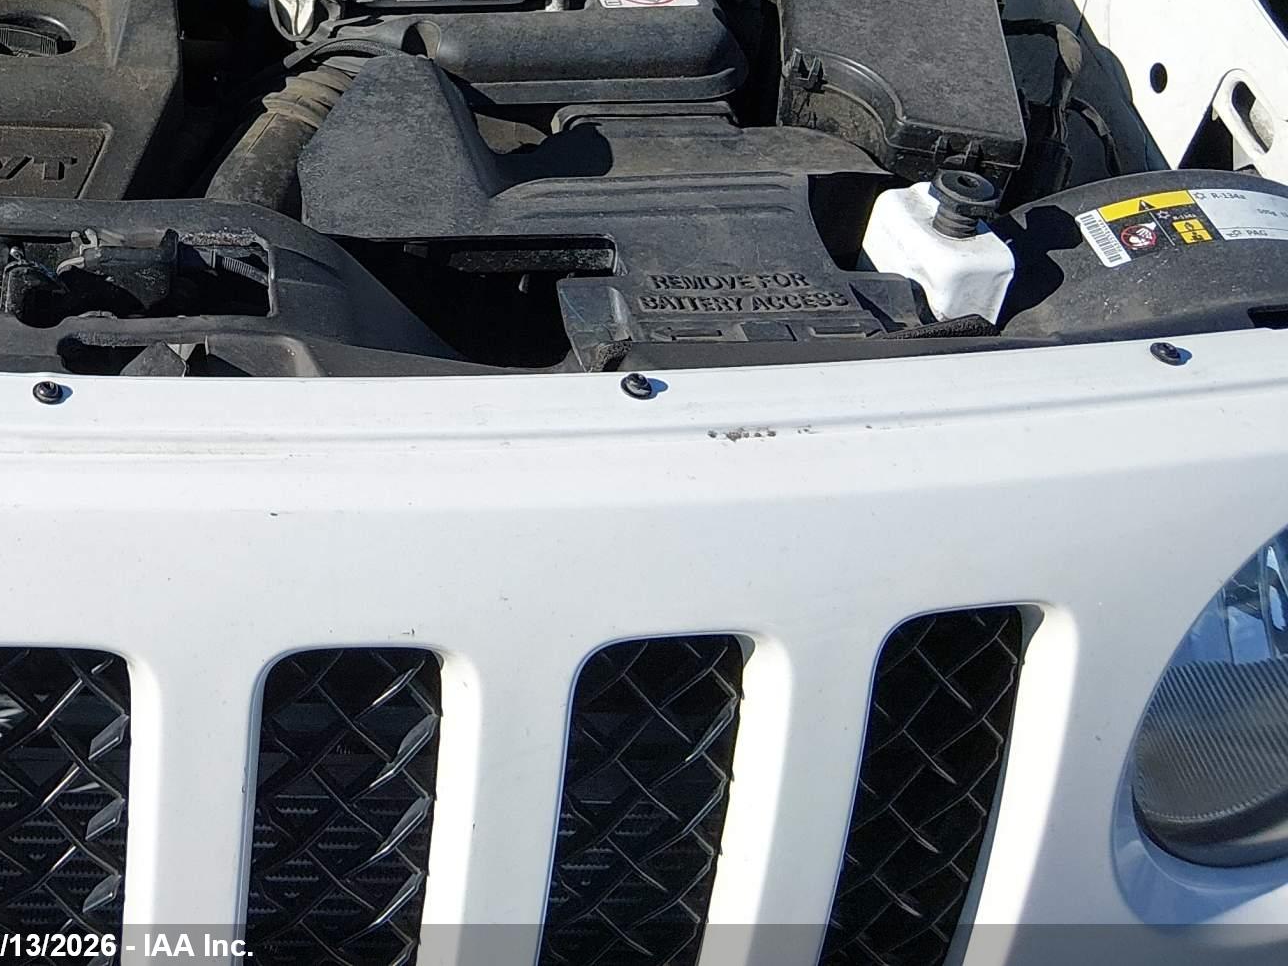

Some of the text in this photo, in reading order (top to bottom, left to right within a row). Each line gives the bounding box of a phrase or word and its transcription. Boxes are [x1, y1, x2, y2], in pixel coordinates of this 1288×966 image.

[647, 272, 811, 290] REMOVE FOR
[640, 292, 850, 312] BATTERY ACCESS
